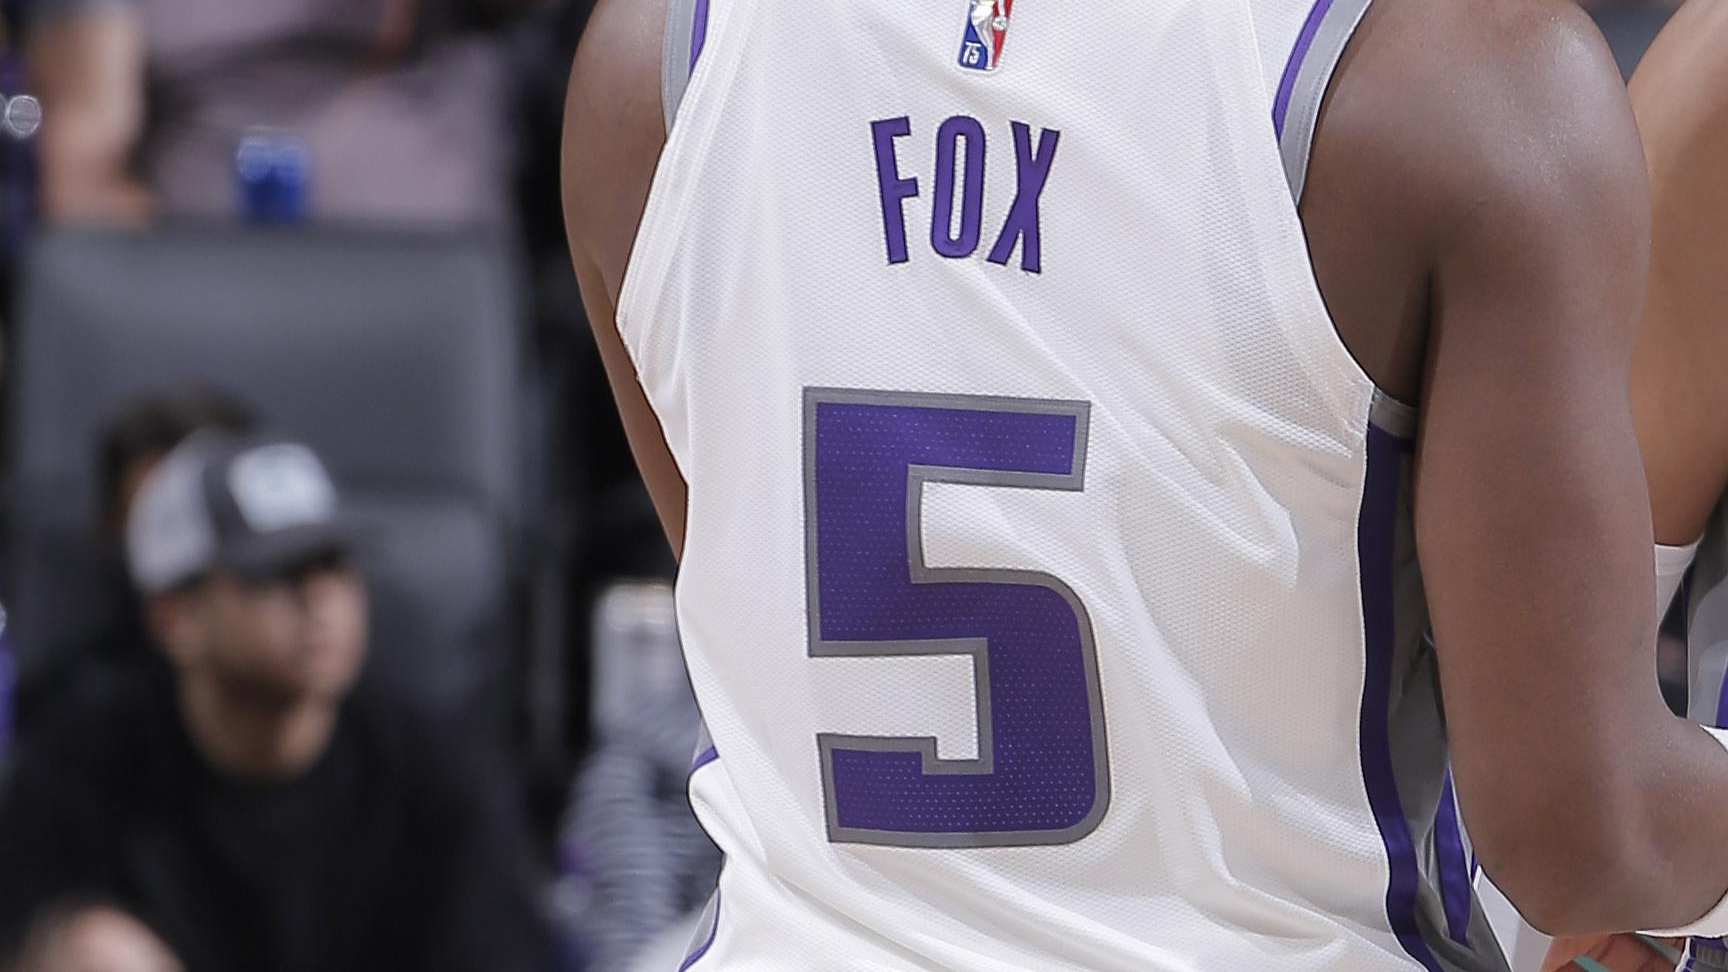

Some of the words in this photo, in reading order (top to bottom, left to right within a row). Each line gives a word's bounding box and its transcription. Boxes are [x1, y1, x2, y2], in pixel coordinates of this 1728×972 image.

[962, 41, 984, 65] 75
[870, 115, 1061, 274] FOX
[802, 386, 1112, 849] 5
